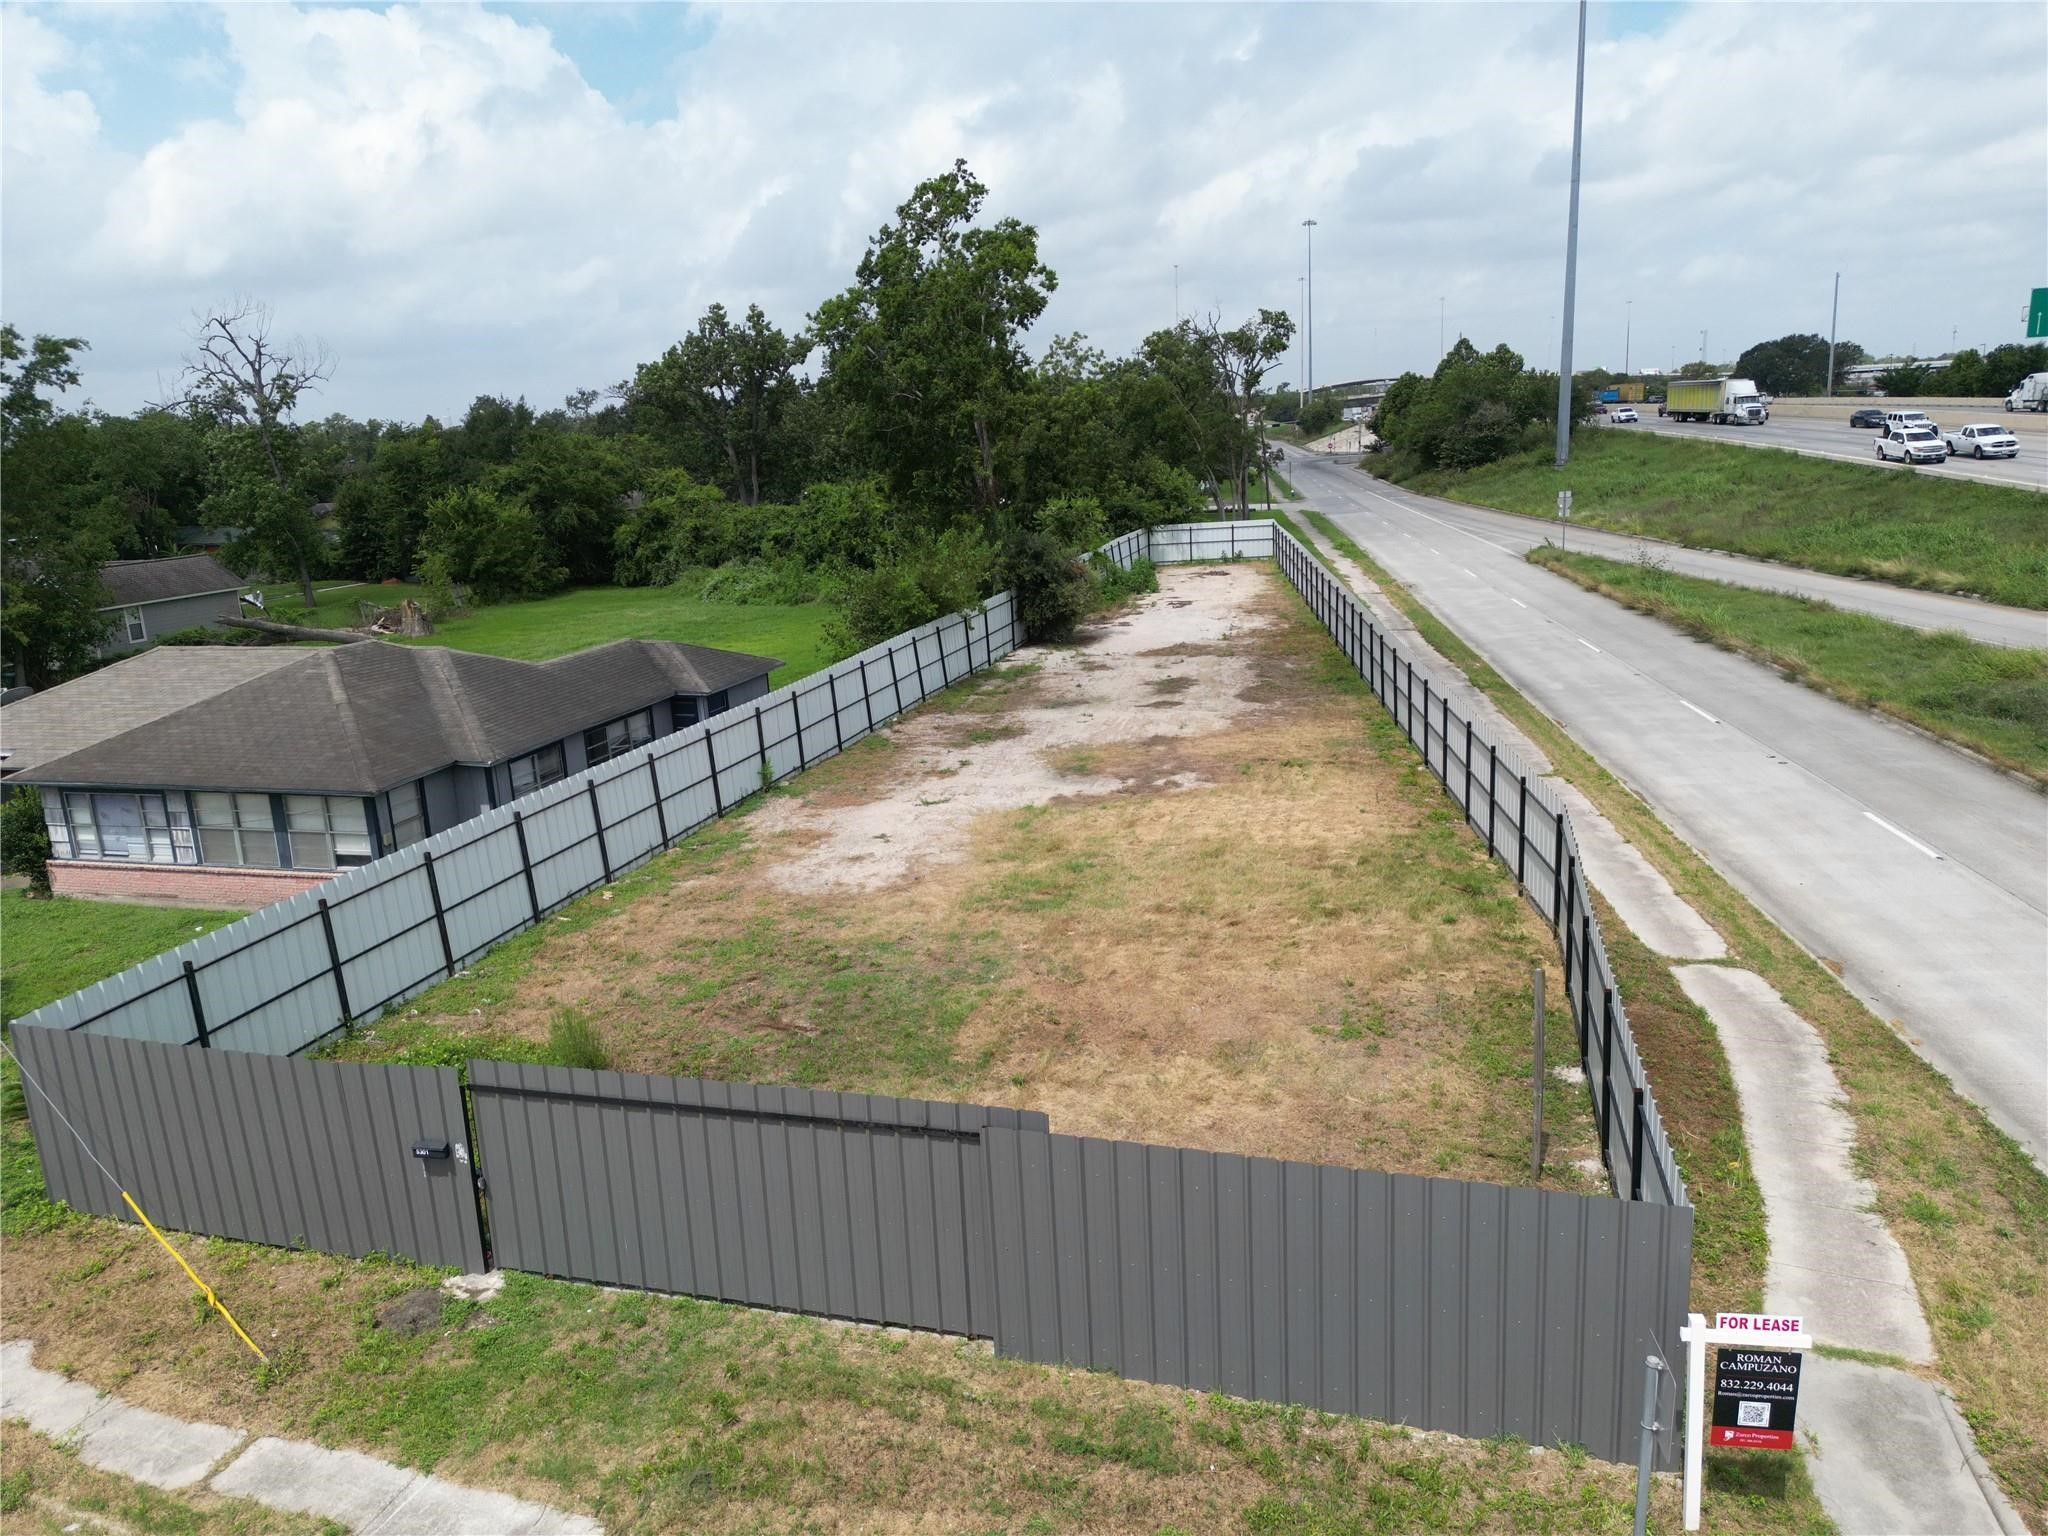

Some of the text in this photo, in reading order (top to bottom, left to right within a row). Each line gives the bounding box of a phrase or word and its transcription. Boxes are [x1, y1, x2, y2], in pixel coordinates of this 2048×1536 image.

[1719, 1316, 1800, 1332] FOR LEASE
[1736, 1353, 1782, 1364] ROMAN
[1719, 1361, 1797, 1374] CAMPUZANO
[1720, 1379, 1794, 1392] 832.229.4044
